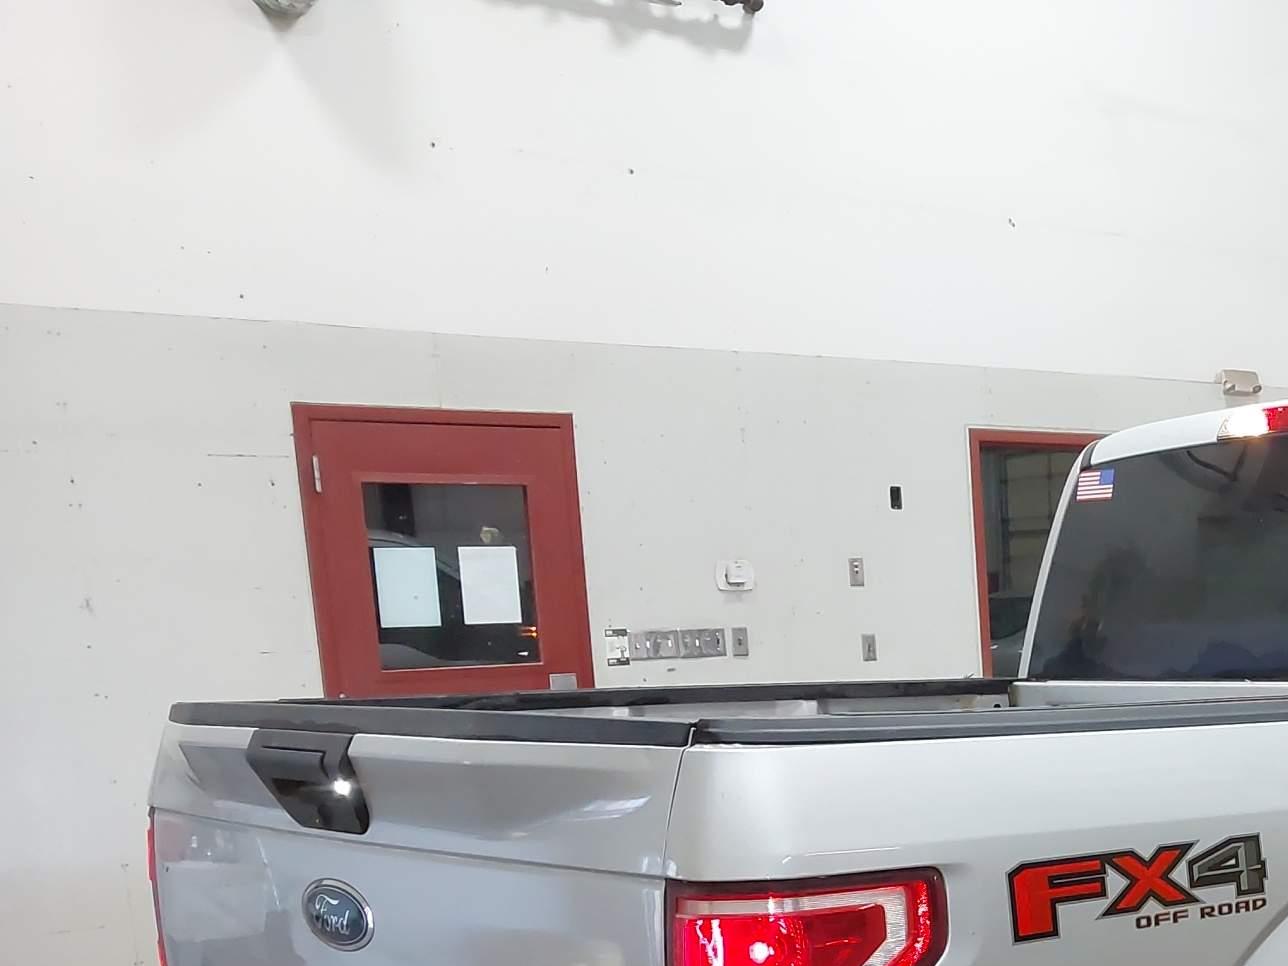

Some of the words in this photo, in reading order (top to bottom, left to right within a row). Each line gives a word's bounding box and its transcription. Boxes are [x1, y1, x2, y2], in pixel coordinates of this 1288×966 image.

[1005, 832, 1269, 945] FX4
[314, 893, 351, 935] Ford
[1135, 908, 1189, 930] OFF
[1199, 897, 1267, 919] ROAD
